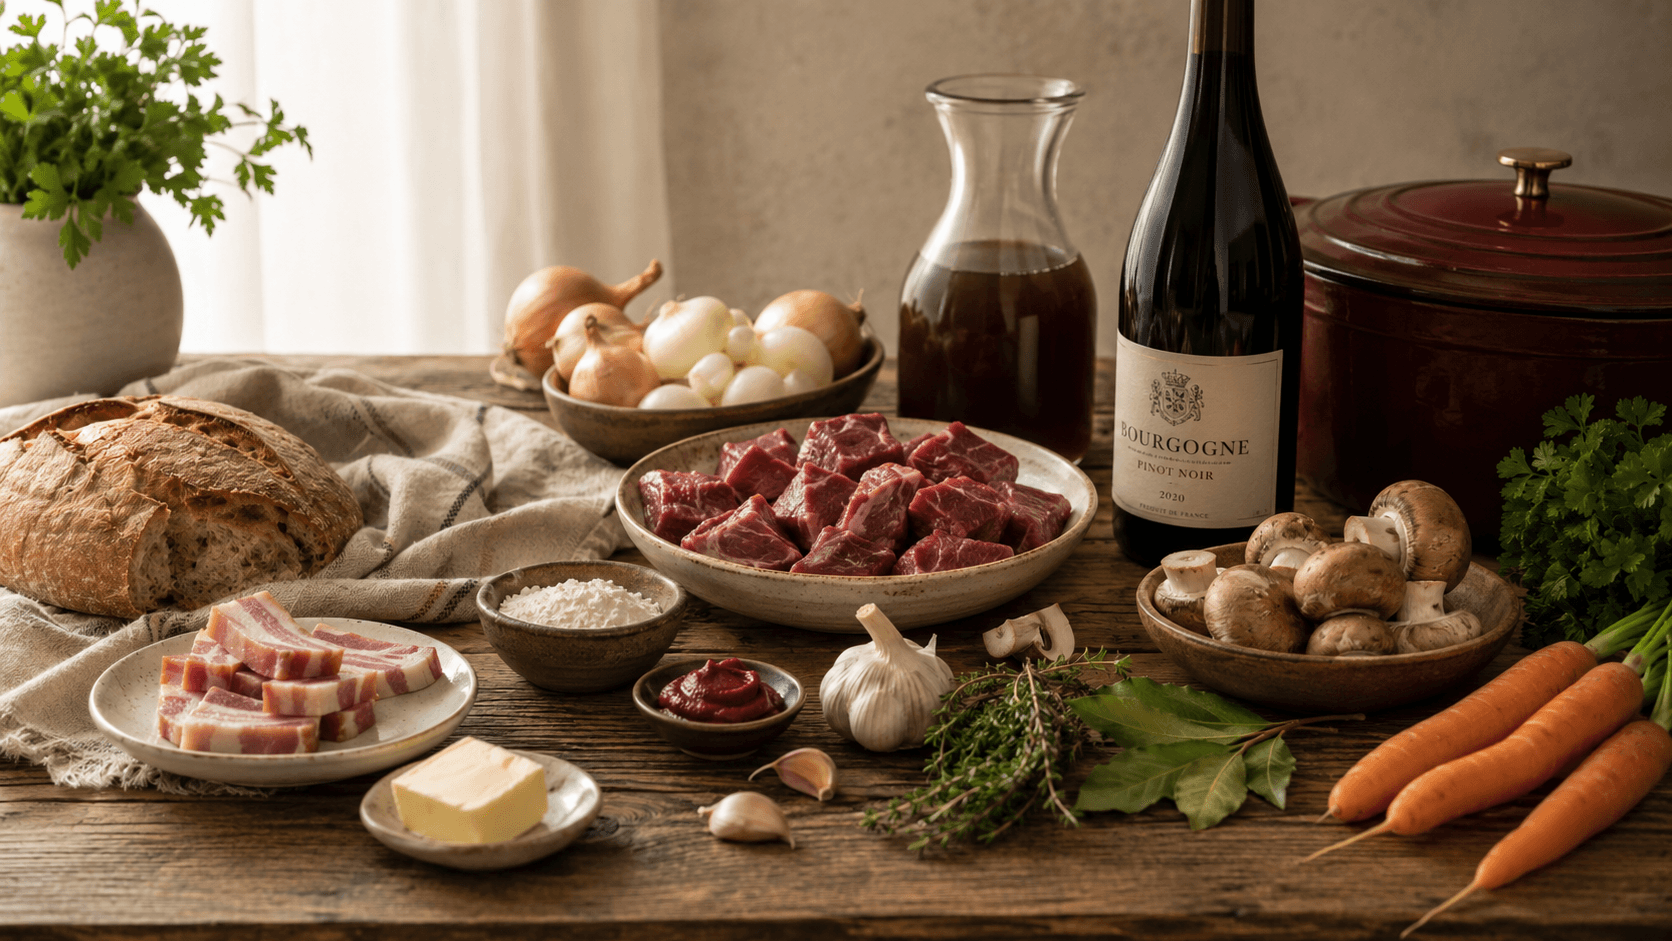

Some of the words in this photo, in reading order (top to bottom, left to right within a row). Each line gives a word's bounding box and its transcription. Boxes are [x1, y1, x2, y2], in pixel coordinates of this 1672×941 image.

[1121, 421, 1249, 456] BOURGOGNE
[1137, 459, 1174, 476] PINOT
[1178, 469, 1214, 480] NOIR
[1159, 490, 1185, 502] 2020
[1180, 511, 1209, 519] FRANCE
